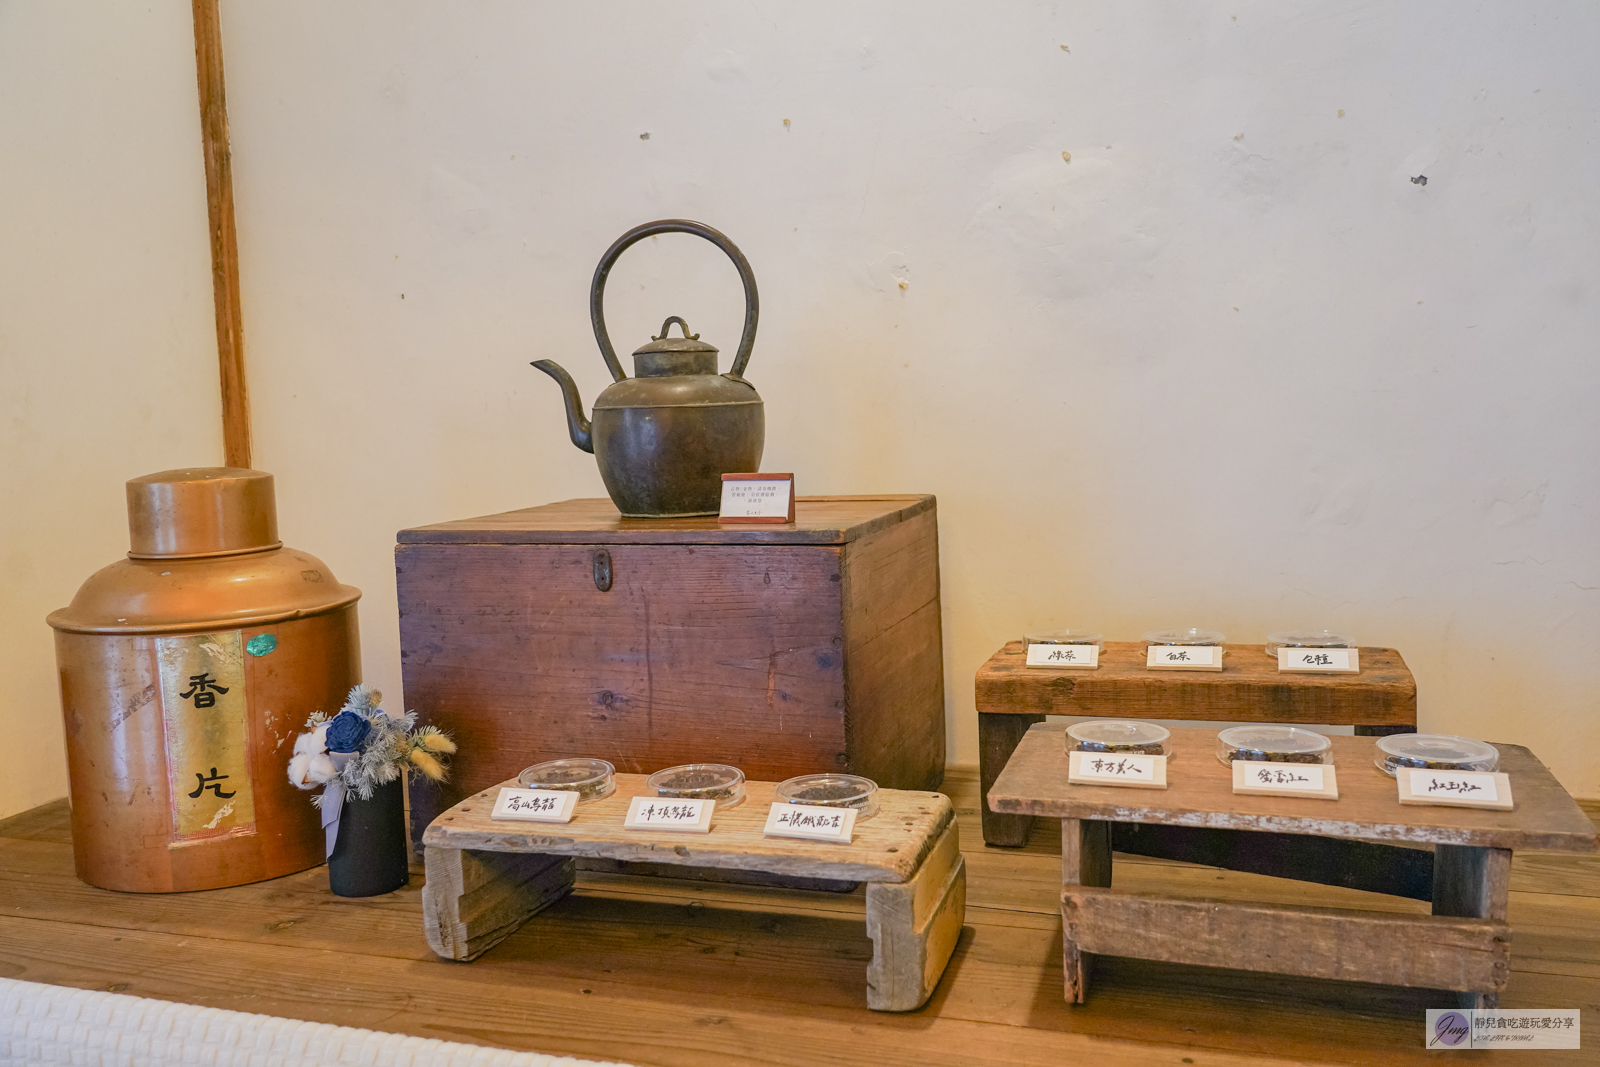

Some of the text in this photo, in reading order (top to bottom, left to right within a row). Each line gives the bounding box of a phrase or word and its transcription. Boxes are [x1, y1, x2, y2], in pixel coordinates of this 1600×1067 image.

[179, 673, 236, 798] 香片
[1091, 758, 1142, 774] 東方美人
[508, 795, 557, 811] 高山烏龍
[641, 804, 695, 821] 凍頂烏龍
